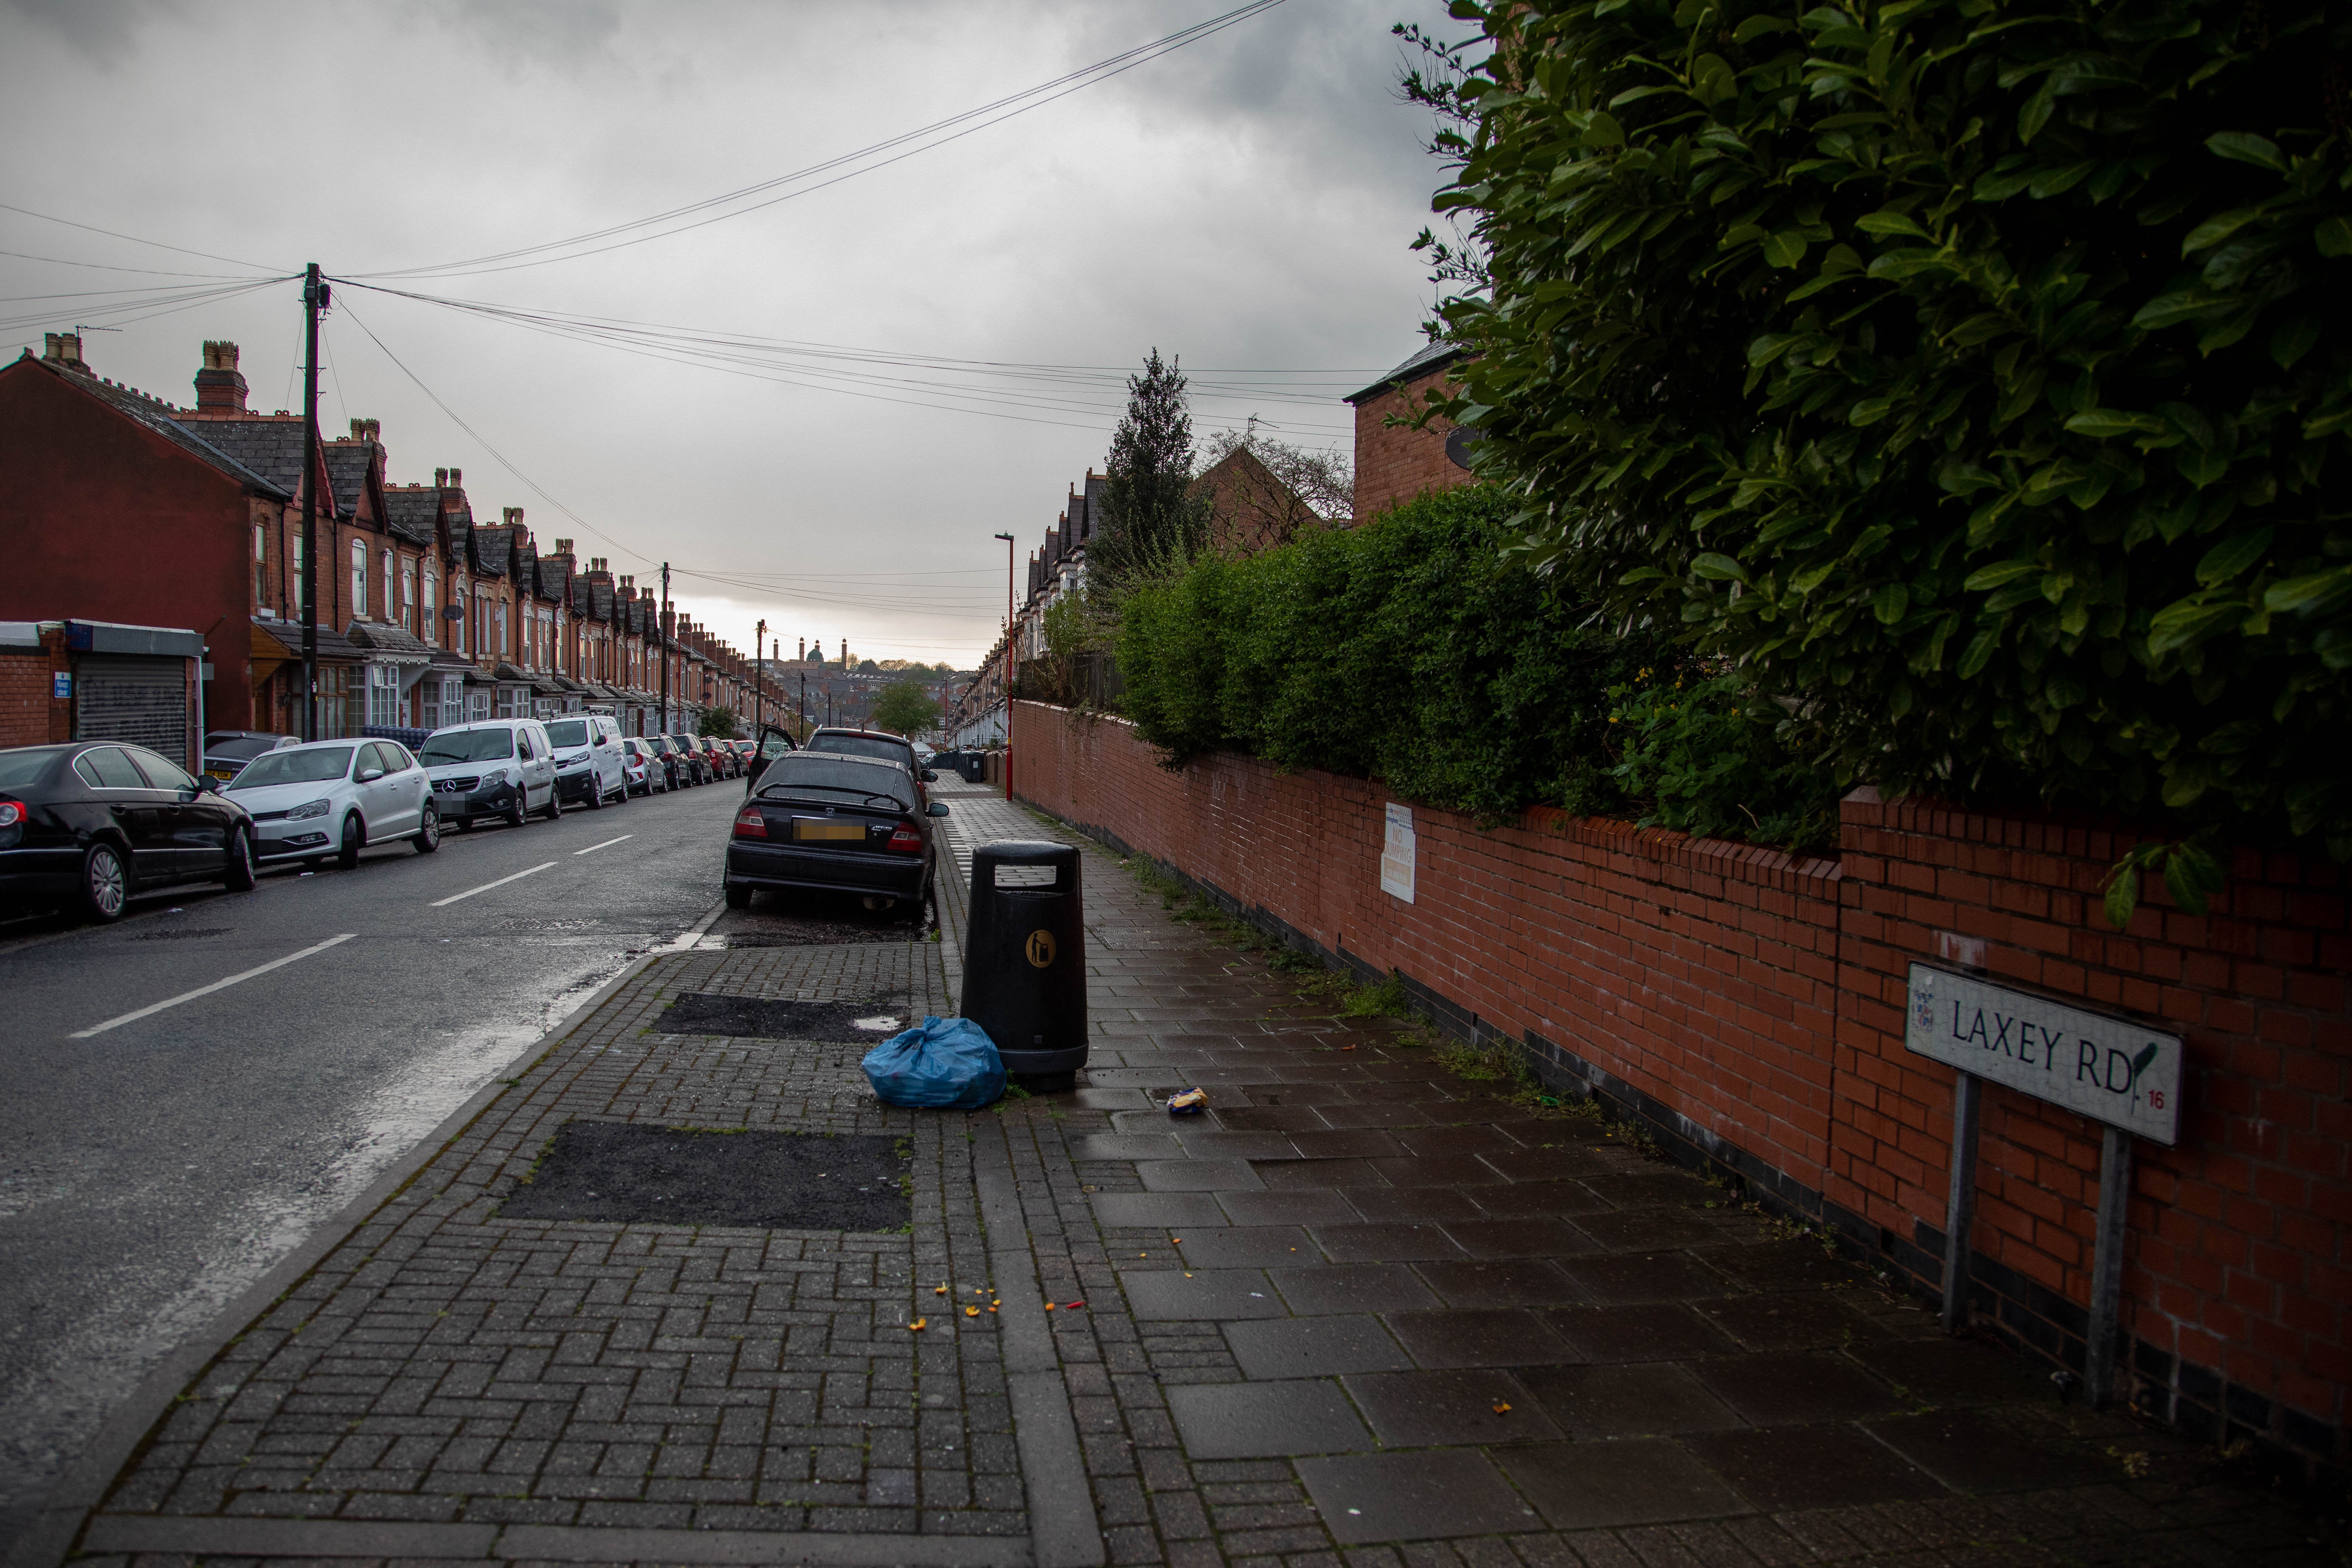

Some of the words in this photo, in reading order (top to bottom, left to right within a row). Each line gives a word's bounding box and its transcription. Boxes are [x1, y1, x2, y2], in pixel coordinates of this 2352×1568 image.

[57, 681, 68, 689] Keep
[1393, 827, 1402, 844] NO
[1384, 840, 1412, 863] DUMPING
[1952, 1000, 2062, 1070] LAXEY
[2148, 1089, 2165, 1110] 16
